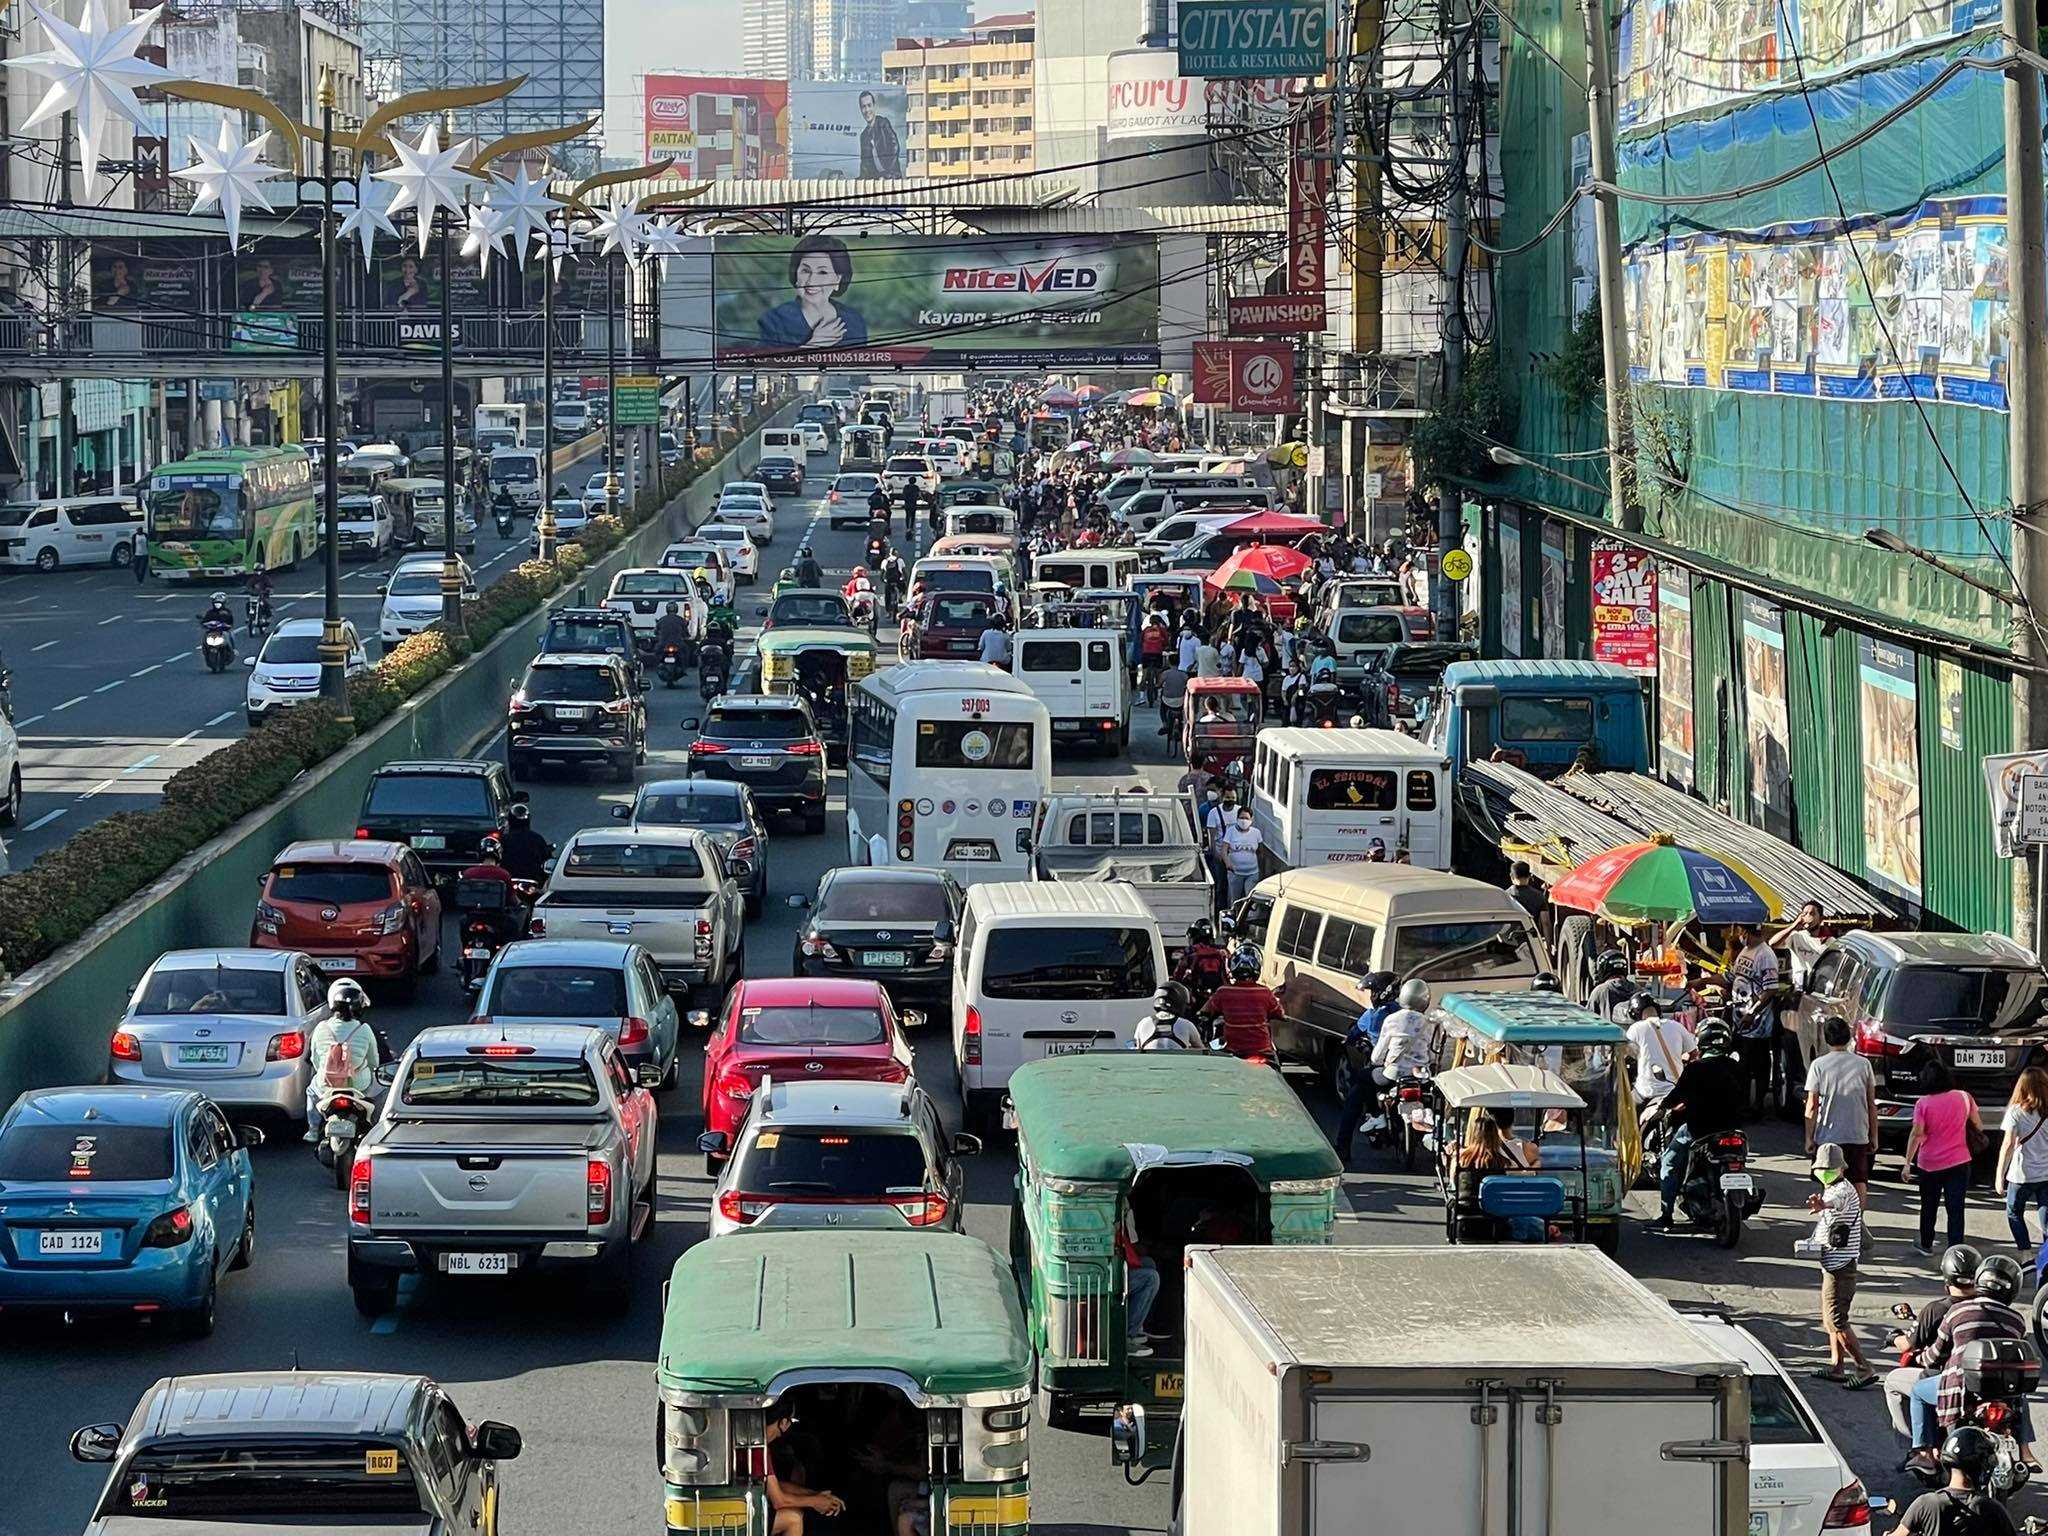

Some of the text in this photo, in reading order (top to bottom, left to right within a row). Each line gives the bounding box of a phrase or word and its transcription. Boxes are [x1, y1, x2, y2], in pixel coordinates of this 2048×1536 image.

[1181, 8, 1324, 49] CITYSTATE
[1185, 53, 1322, 68] HOTEL & RESTAURANT
[653, 132, 692, 145] RATTAN
[652, 150, 692, 160] LIFESTYLE
[944, 258, 1098, 294] RiteMED
[918, 310, 987, 327] Kayang
[1229, 304, 1324, 325] PAWNSHOP
[400, 325, 460, 339] DAVIS
[1601, 585, 1652, 606] SALE
[1956, 1053, 2004, 1064] DAH 7388
[42, 1235, 100, 1248] CAD 1124
[450, 1257, 506, 1269] NBL 6231
